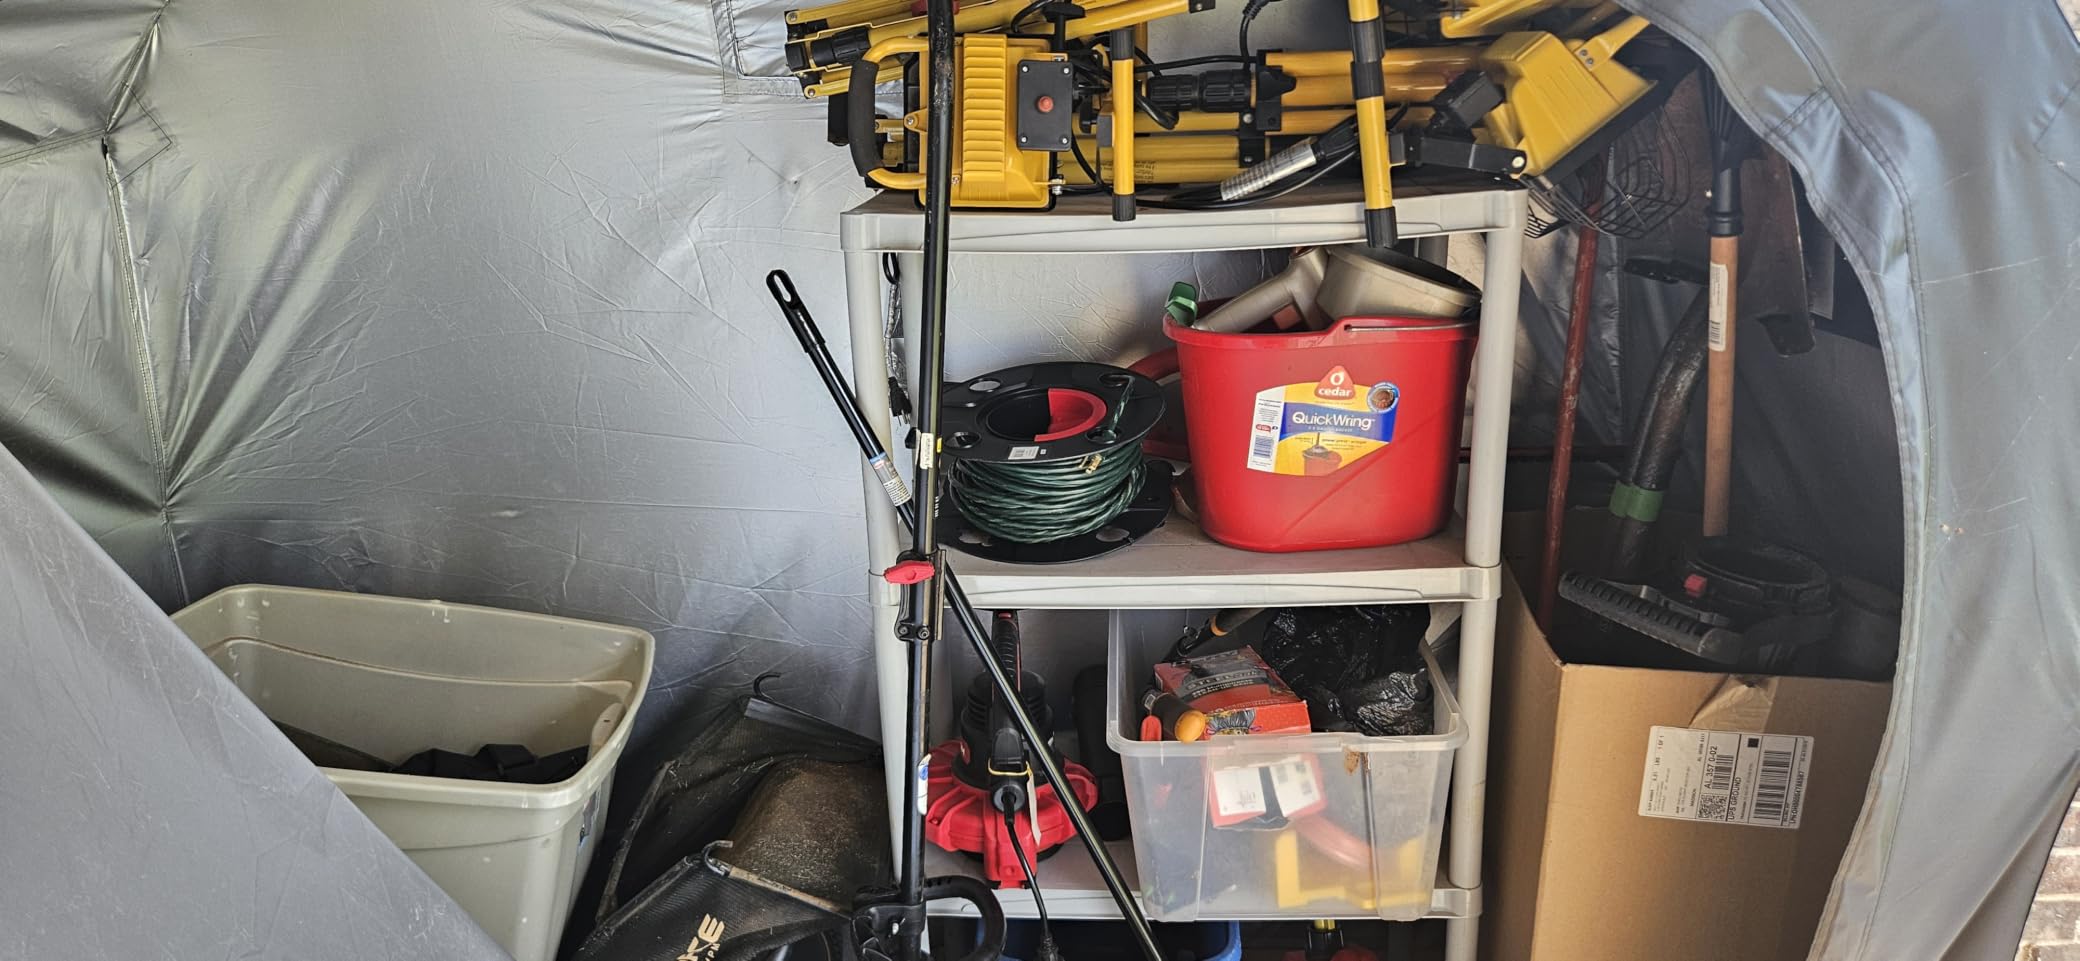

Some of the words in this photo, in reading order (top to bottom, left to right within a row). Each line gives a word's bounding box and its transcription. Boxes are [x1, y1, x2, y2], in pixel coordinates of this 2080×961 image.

[1318, 386, 1353, 397] cedar
[1292, 412, 1371, 431] QuickWring
[1708, 745, 1718, 762] 0-02
[1705, 764, 1715, 777] 357
[1704, 777, 1712, 789] AL
[1730, 777, 1741, 806] GROUND
[1728, 806, 1737, 820] UPS
